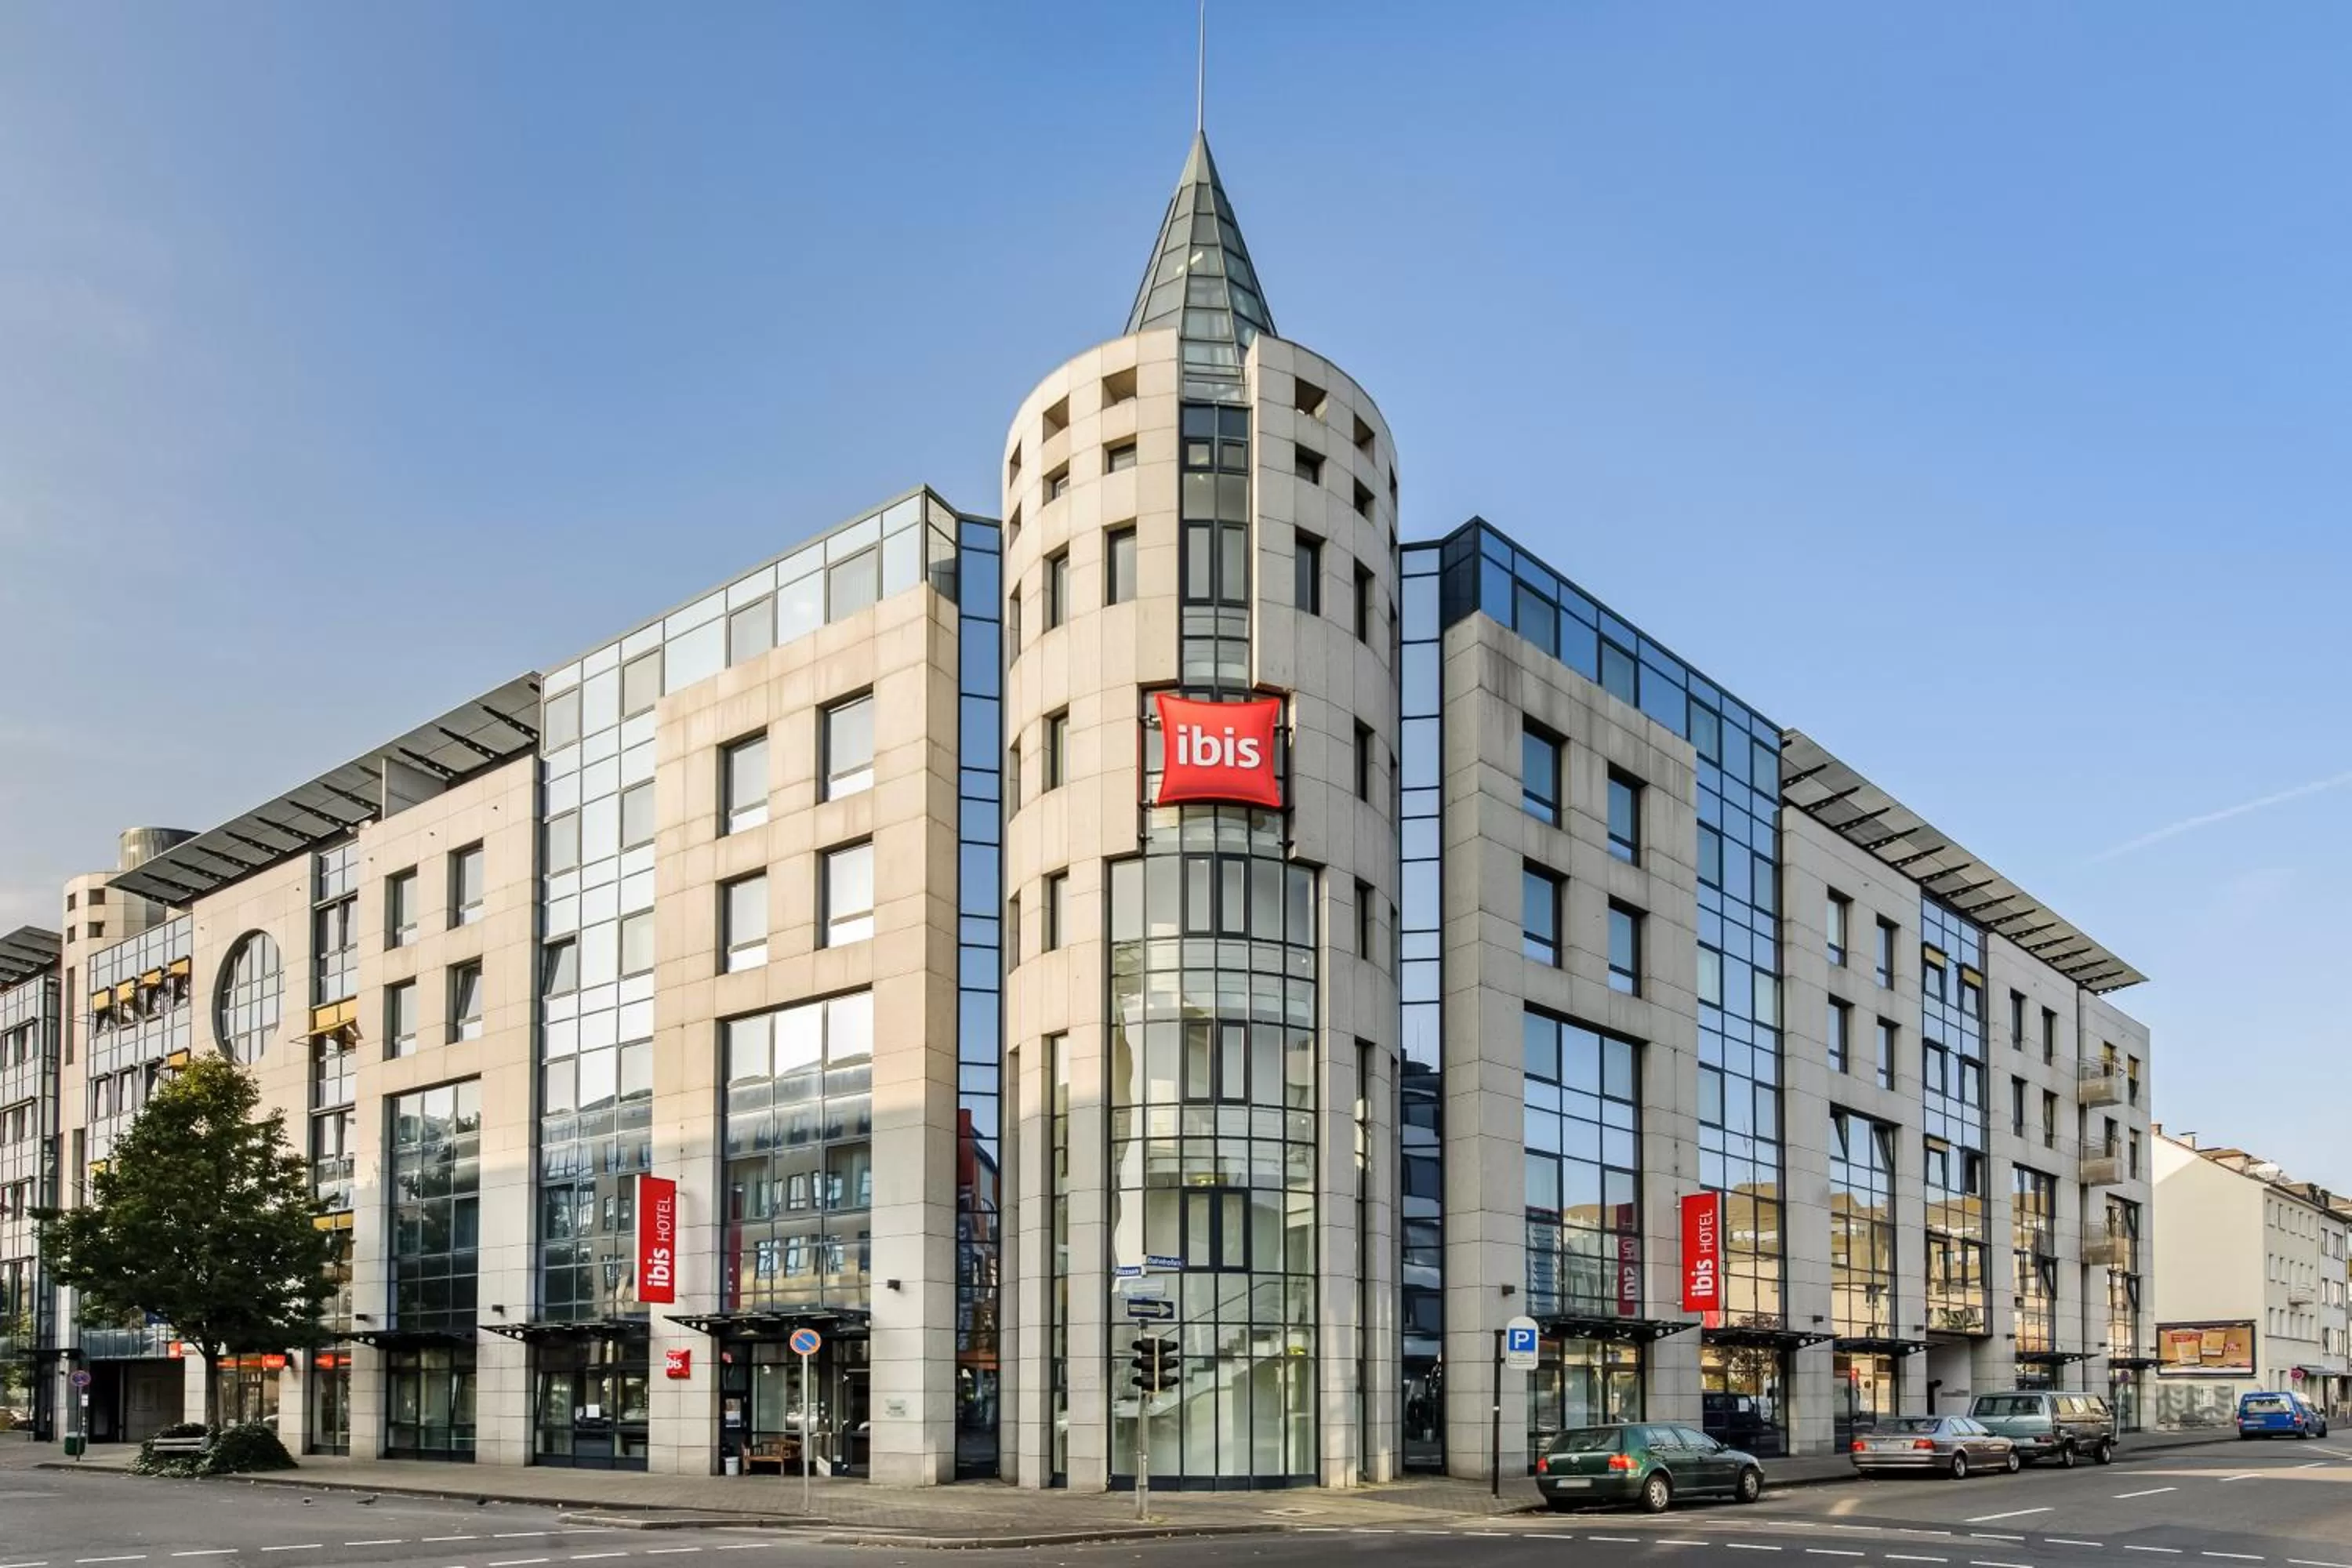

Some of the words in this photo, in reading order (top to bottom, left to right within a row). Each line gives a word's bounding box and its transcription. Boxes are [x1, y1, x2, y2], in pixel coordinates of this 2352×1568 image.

[1178, 724, 1261, 768] ibis
[656, 1196, 670, 1242] HOTEL
[1700, 1209, 1713, 1254] HOTEL
[647, 1247, 670, 1287] ibis
[1691, 1258, 1713, 1296] ibis
[1515, 1330, 1530, 1348] P
